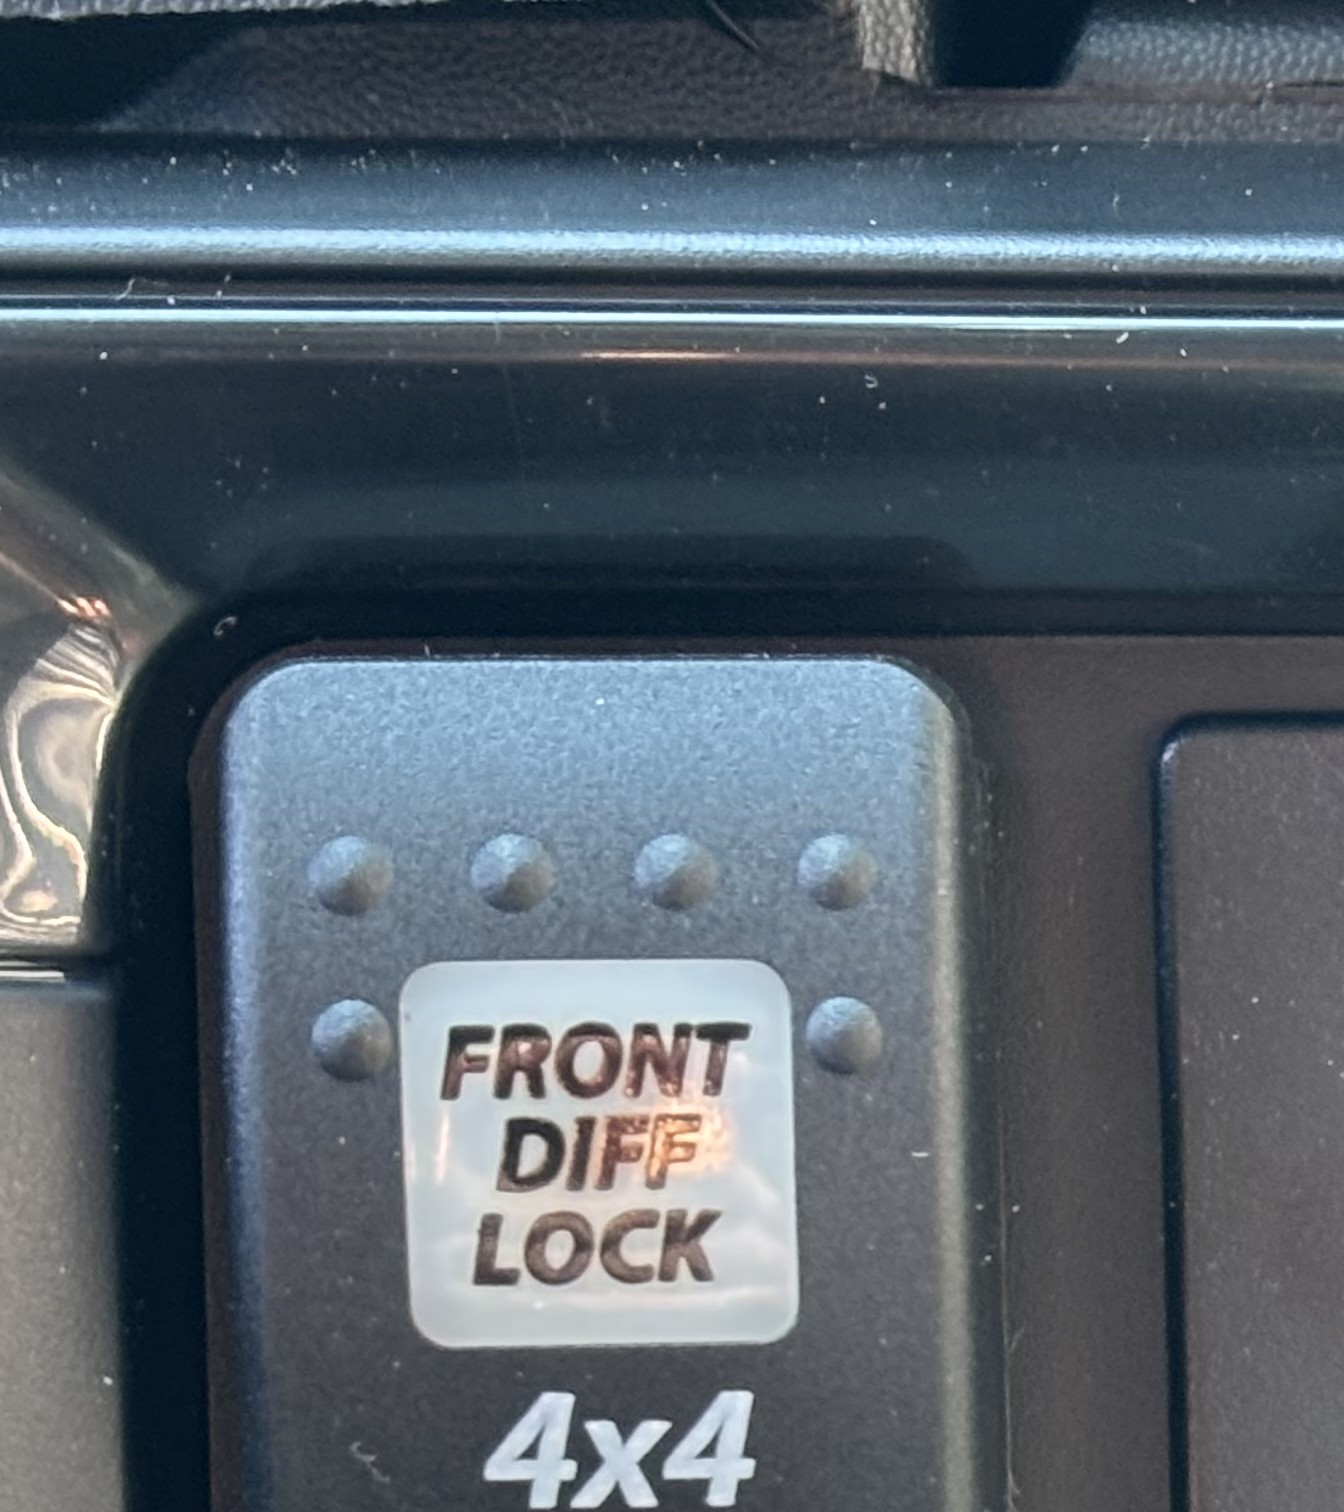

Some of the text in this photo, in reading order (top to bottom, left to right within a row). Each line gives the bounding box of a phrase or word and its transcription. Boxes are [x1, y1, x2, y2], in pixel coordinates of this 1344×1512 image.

[441, 1022, 752, 1100] FRONT
[497, 1114, 702, 1192] DIFF
[472, 1208, 723, 1286] LOCK
[484, 1390, 756, 1509] 4x4
